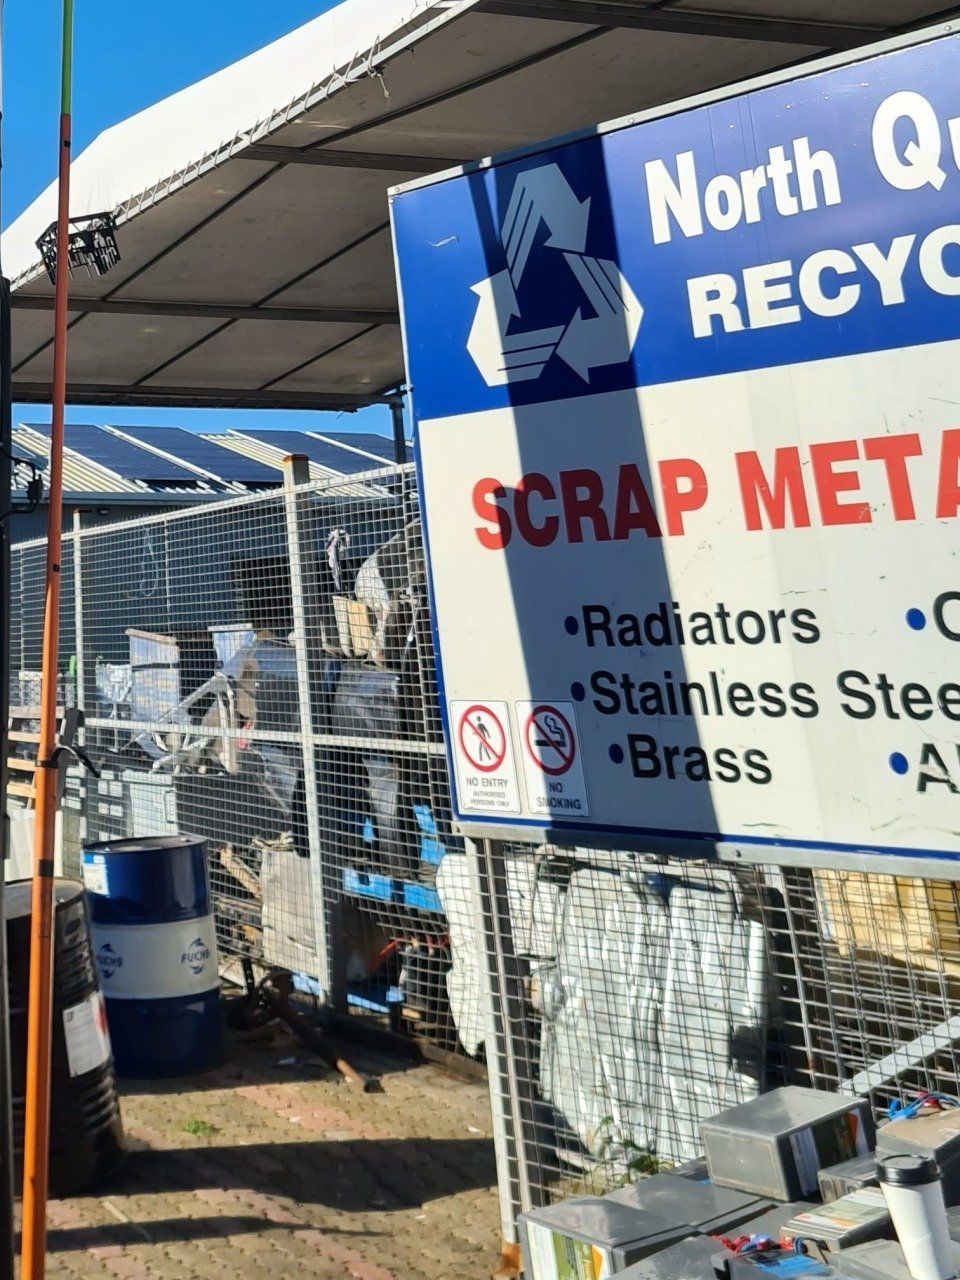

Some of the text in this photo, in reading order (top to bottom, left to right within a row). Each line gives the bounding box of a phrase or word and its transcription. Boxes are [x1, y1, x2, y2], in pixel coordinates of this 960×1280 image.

[644, 136, 841, 245] North
[471, 457, 709, 550] SCRAP
[581, 601, 820, 648] Radiators
[590, 670, 819, 719] Stainless
[466, 777, 508, 788] NO ENTRY
[627, 733, 773, 785] Brass
[536, 796, 582, 810] SMOKING
[549, 782, 562, 793] NO
[180, 948, 210, 964] FUCHS
